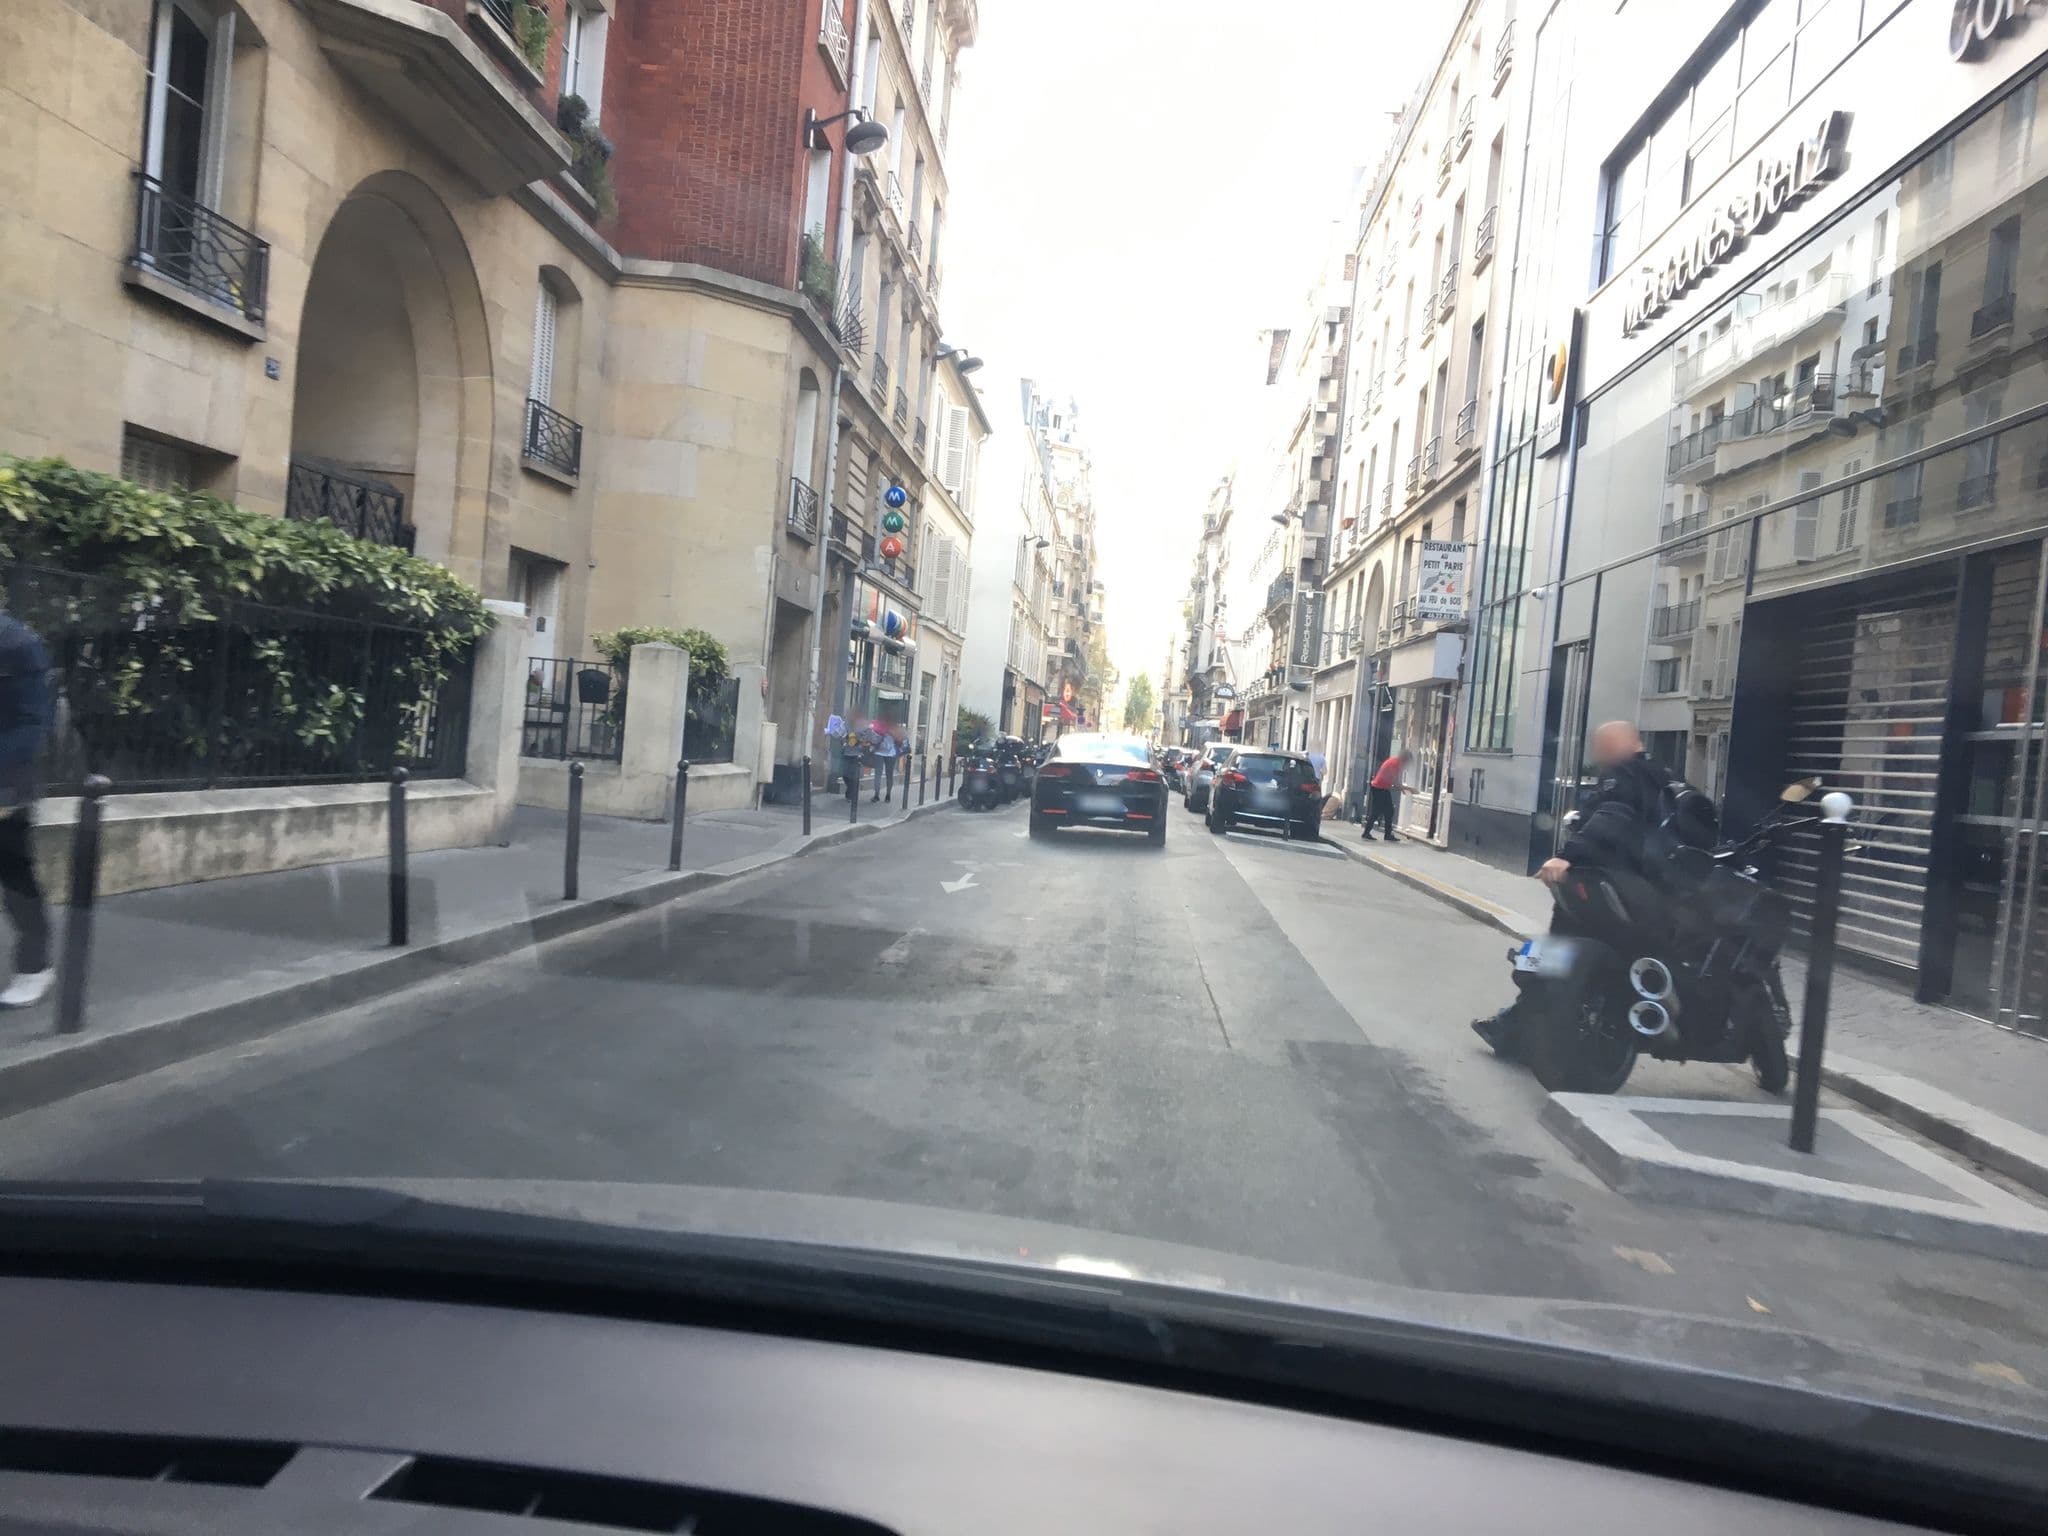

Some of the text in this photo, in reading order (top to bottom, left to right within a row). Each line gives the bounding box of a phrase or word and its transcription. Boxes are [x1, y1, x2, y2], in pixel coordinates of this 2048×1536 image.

[1424, 542, 1466, 553] RESTAURANT
[1424, 560, 1463, 571] PETIT PARIS
